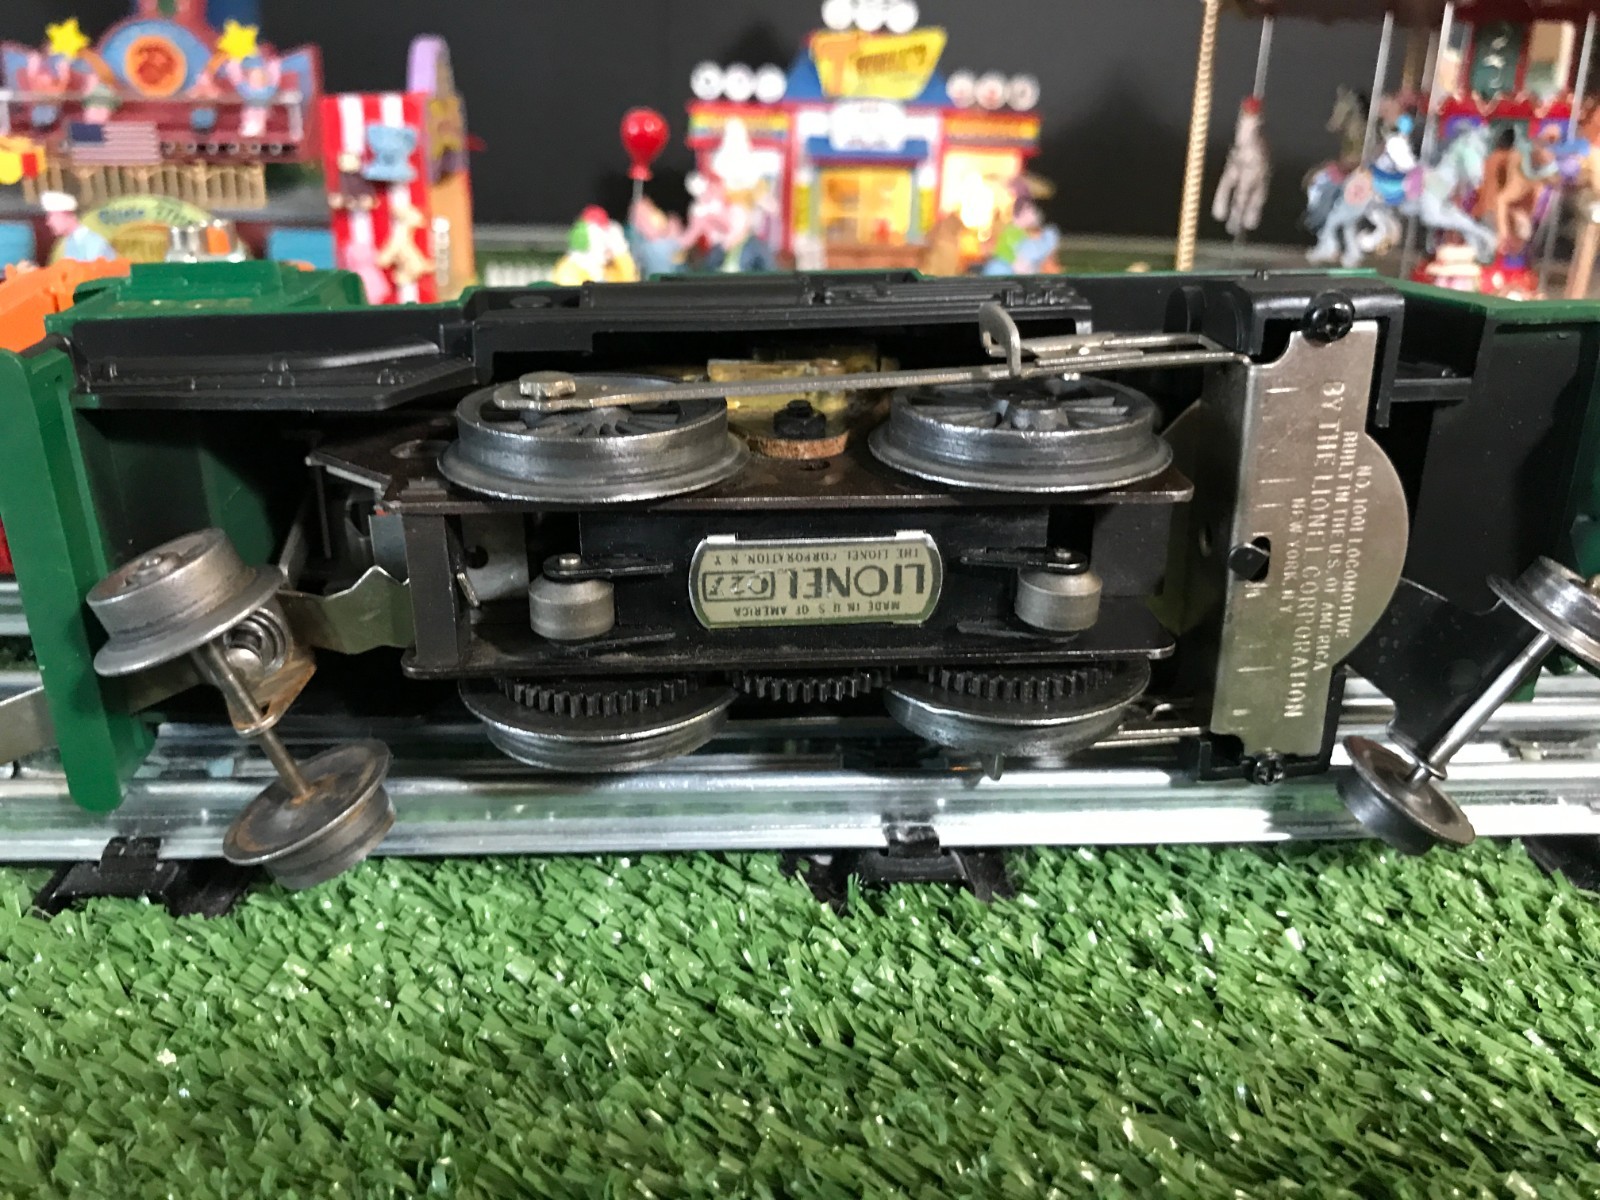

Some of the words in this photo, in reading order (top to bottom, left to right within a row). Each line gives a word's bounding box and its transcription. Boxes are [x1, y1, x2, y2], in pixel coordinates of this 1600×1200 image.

[1321, 382, 1345, 411] BY
[1314, 419, 1340, 467] THE
[1338, 432, 1358, 481] BUILT
[1355, 466, 1372, 492] NO.
[1335, 486, 1351, 502] IN
[1289, 498, 1306, 533] NEW
[1303, 476, 1333, 559] LIONEL
[1332, 509, 1348, 537] THE
[1349, 499, 1368, 531] 1001
[845, 549, 888, 560] LIONEL
[896, 549, 918, 558] THE
[1325, 544, 1343, 574] U.S.
[778, 564, 925, 599] LIONEL
[1325, 577, 1338, 594] OF
[1335, 539, 1362, 638] LOCOMOTIVE
[734, 606, 787, 616] AMERICA
[796, 605, 809, 615] OF
[847, 603, 859, 612] IN
[868, 601, 899, 611] MADE
[1284, 566, 1320, 718] CORPORATION
[1313, 603, 1333, 671] AMERICA
